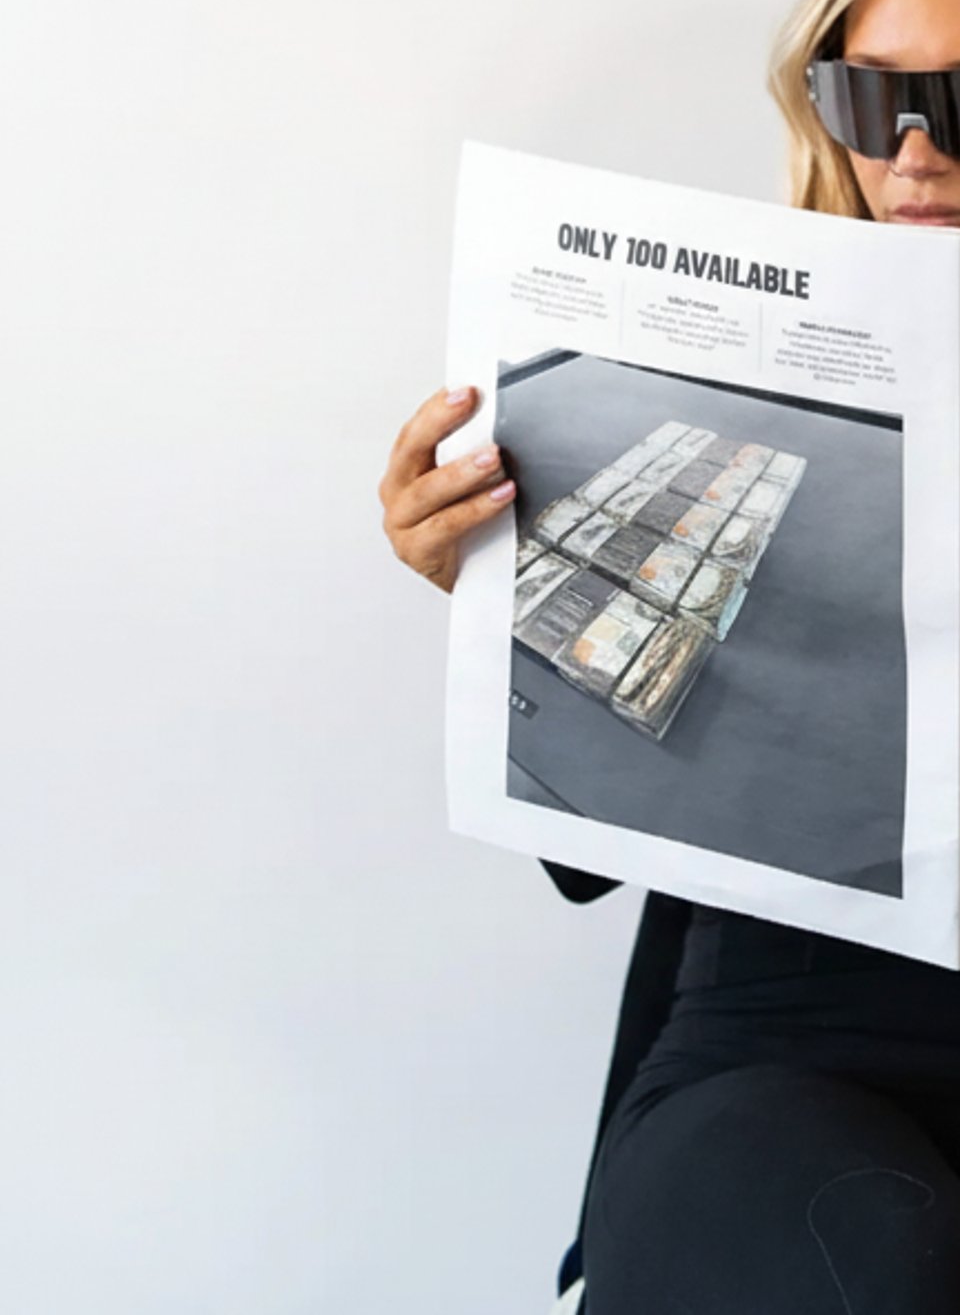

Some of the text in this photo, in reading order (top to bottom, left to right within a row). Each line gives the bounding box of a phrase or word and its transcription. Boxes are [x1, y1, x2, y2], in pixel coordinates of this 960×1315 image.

[557, 222, 810, 300] ONLY 100 AVAILABLE
